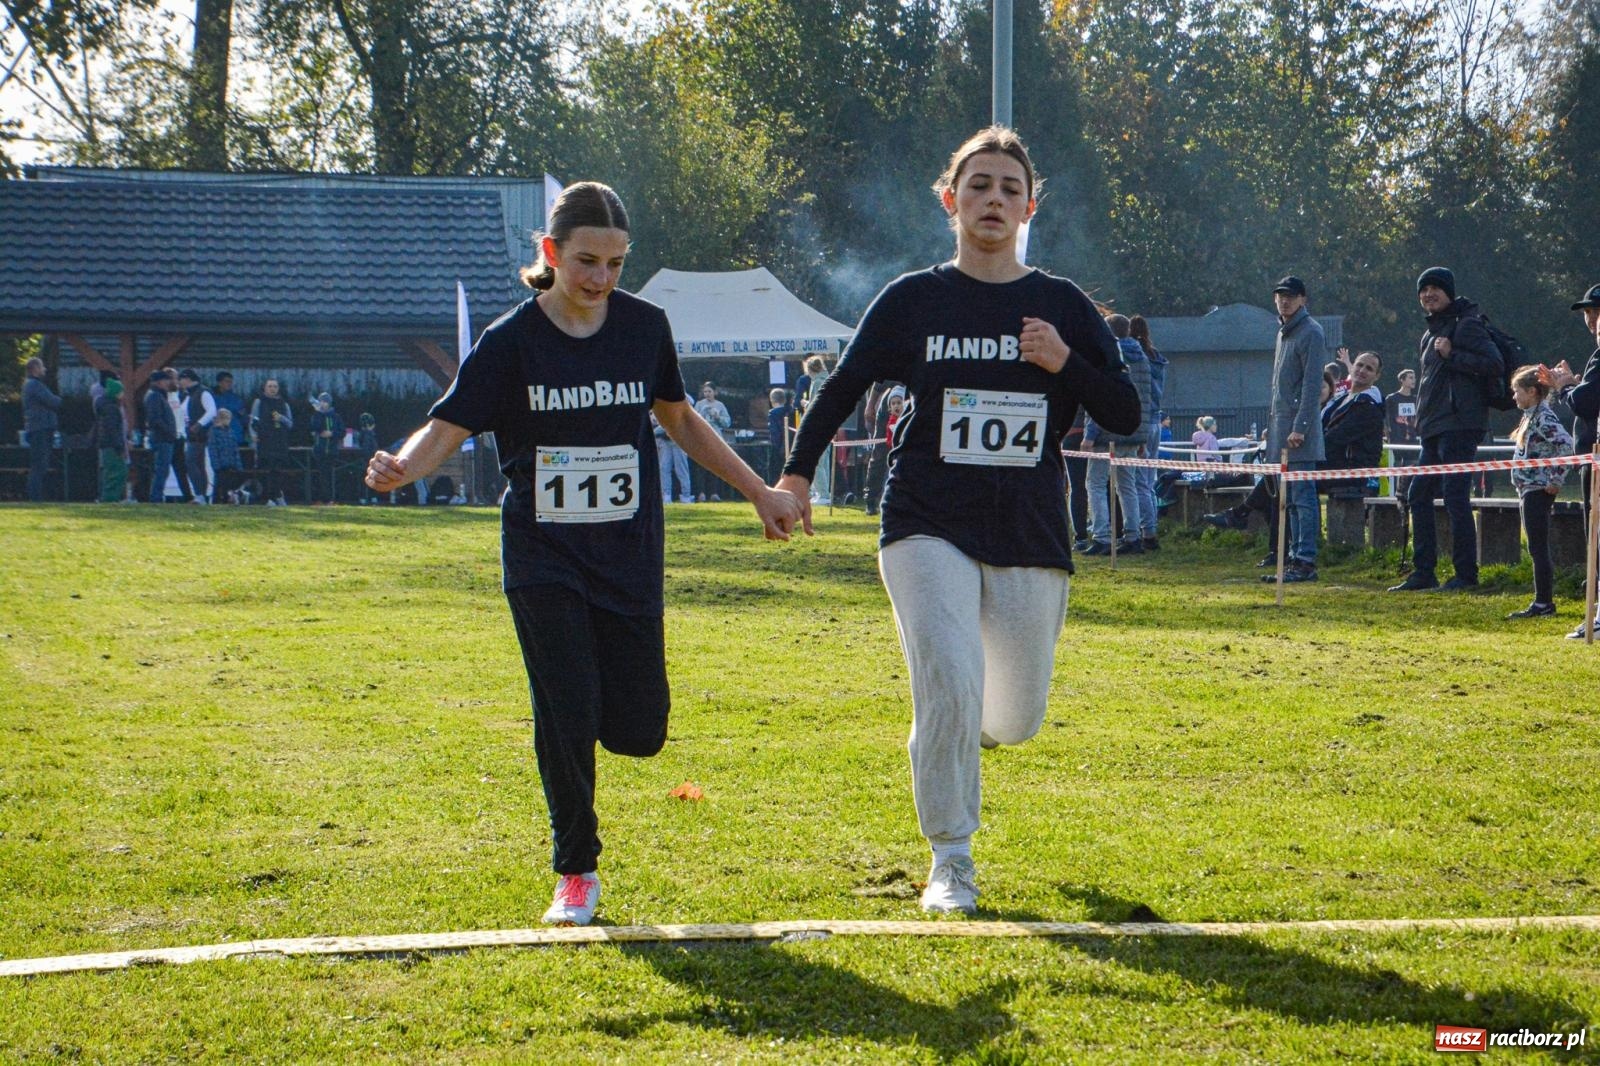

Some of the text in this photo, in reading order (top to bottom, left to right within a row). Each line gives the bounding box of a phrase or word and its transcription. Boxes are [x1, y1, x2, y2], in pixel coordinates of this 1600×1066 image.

[691, 341, 726, 353] AKTYWNI
[733, 340, 749, 353] DLA
[756, 339, 796, 352] LEPSZEGO
[802, 338, 828, 351] JUTRA
[926, 334, 1026, 362] HANDB
[981, 399, 1044, 409] www.personalbest.pl
[950, 416, 1039, 453] 104
[574, 451, 637, 463] www.personalbest.pl
[544, 472, 634, 509] 113
